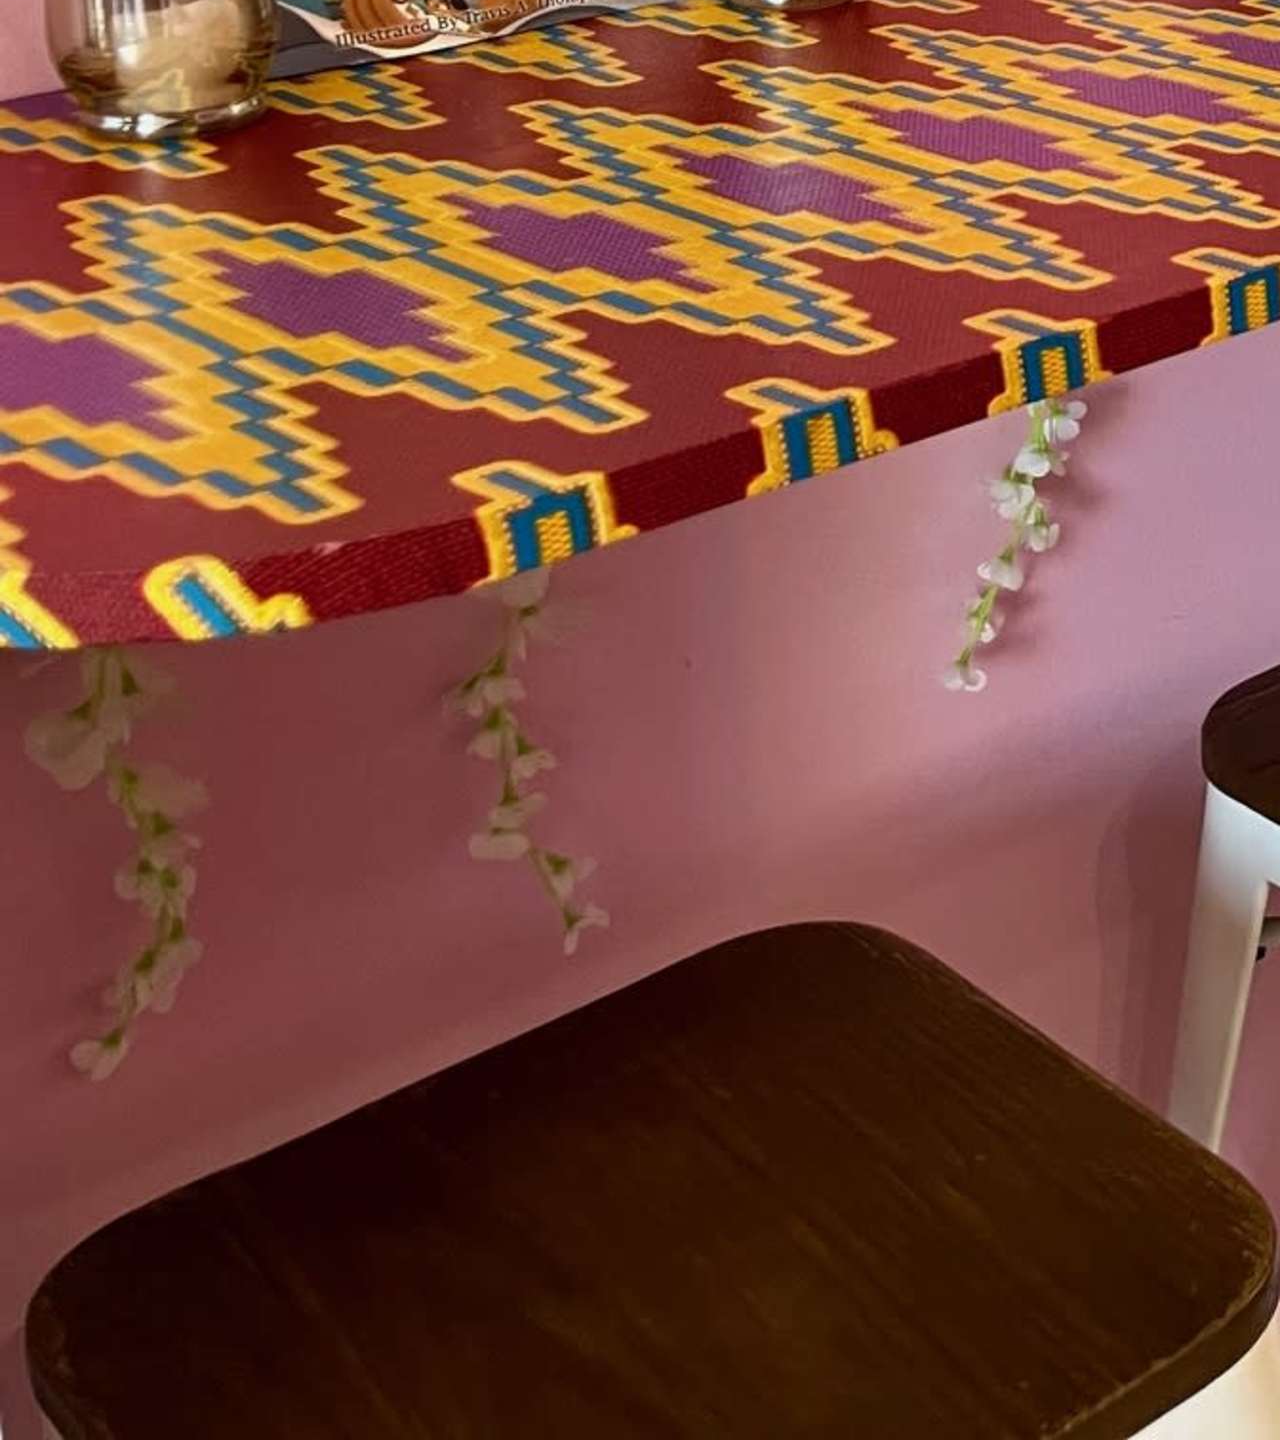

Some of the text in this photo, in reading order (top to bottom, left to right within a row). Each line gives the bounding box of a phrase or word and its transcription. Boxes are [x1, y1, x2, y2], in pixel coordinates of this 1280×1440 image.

[334, 16, 431, 49] Illustrated
[438, 15, 458, 33] By
[464, 5, 510, 25] Travis
